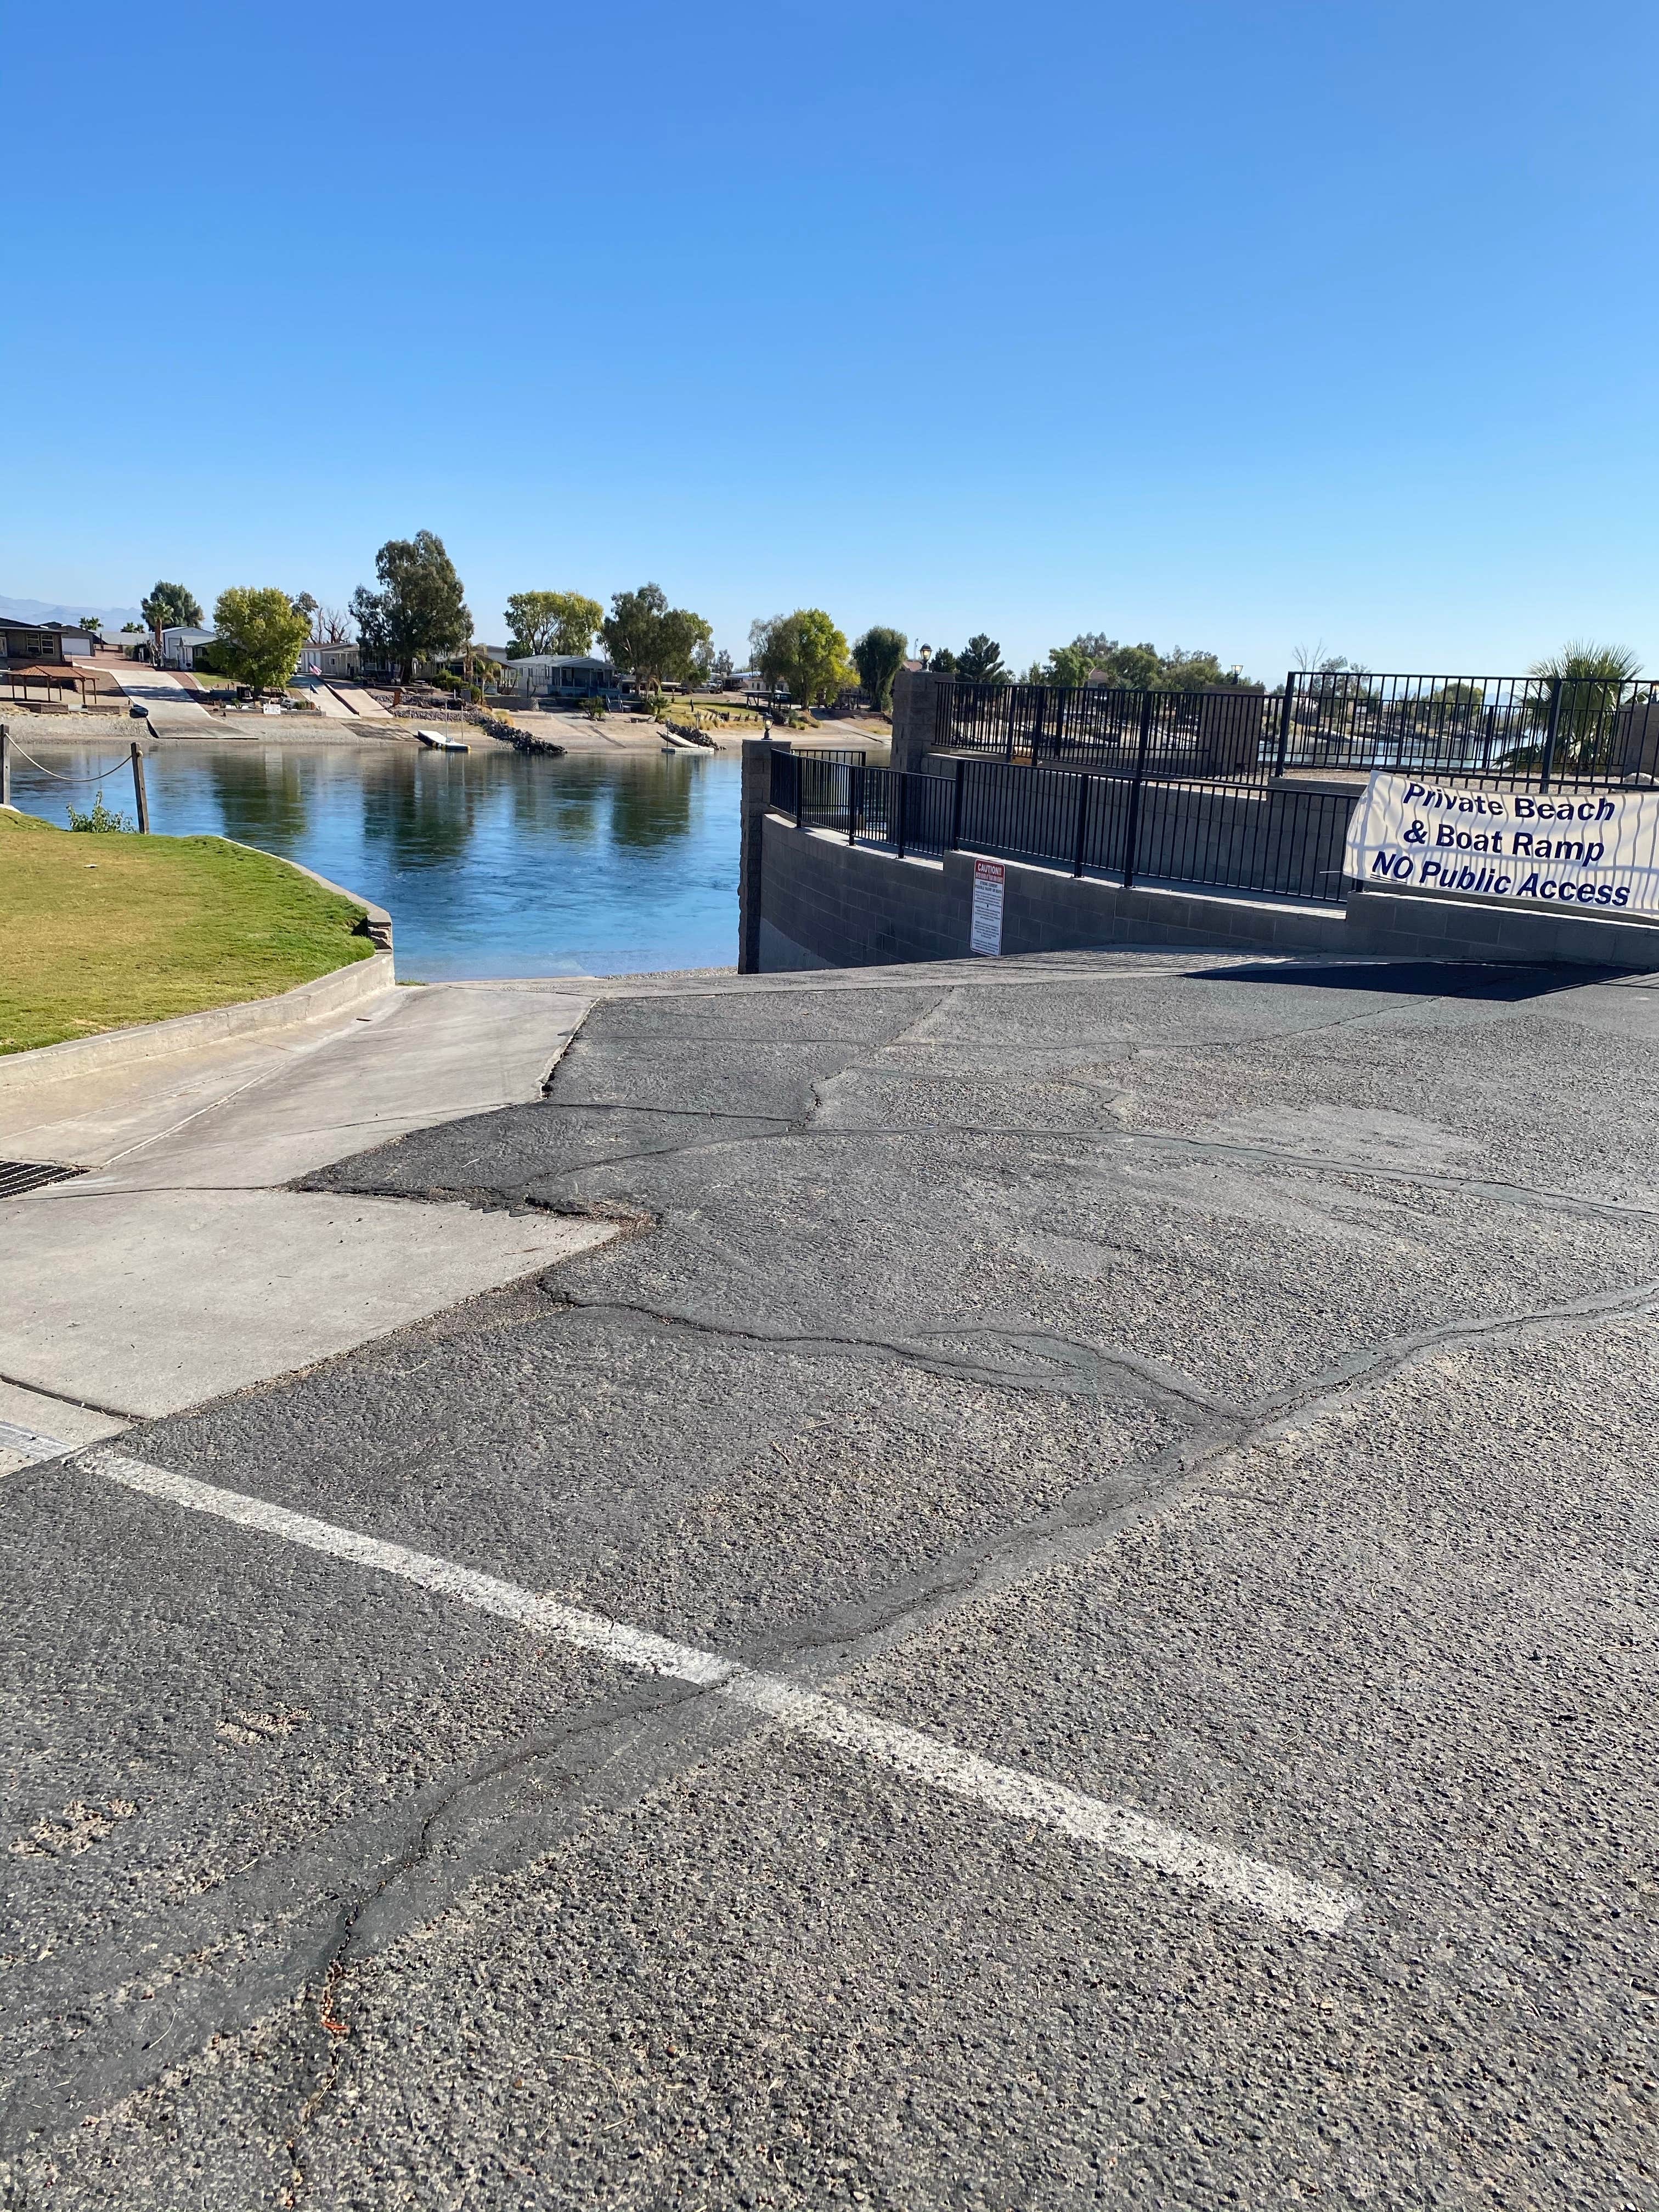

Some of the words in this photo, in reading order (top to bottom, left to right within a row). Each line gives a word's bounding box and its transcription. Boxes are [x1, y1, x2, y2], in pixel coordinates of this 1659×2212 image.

[1403, 782, 1504, 816] Private
[1515, 797, 1616, 821] Beach
[1403, 820, 1429, 845] &
[1436, 823, 1503, 854] Boat
[1511, 832, 1605, 867] Ramp
[1371, 851, 1414, 880] NO
[1419, 860, 1511, 895] Public
[1515, 872, 1631, 906] Access
